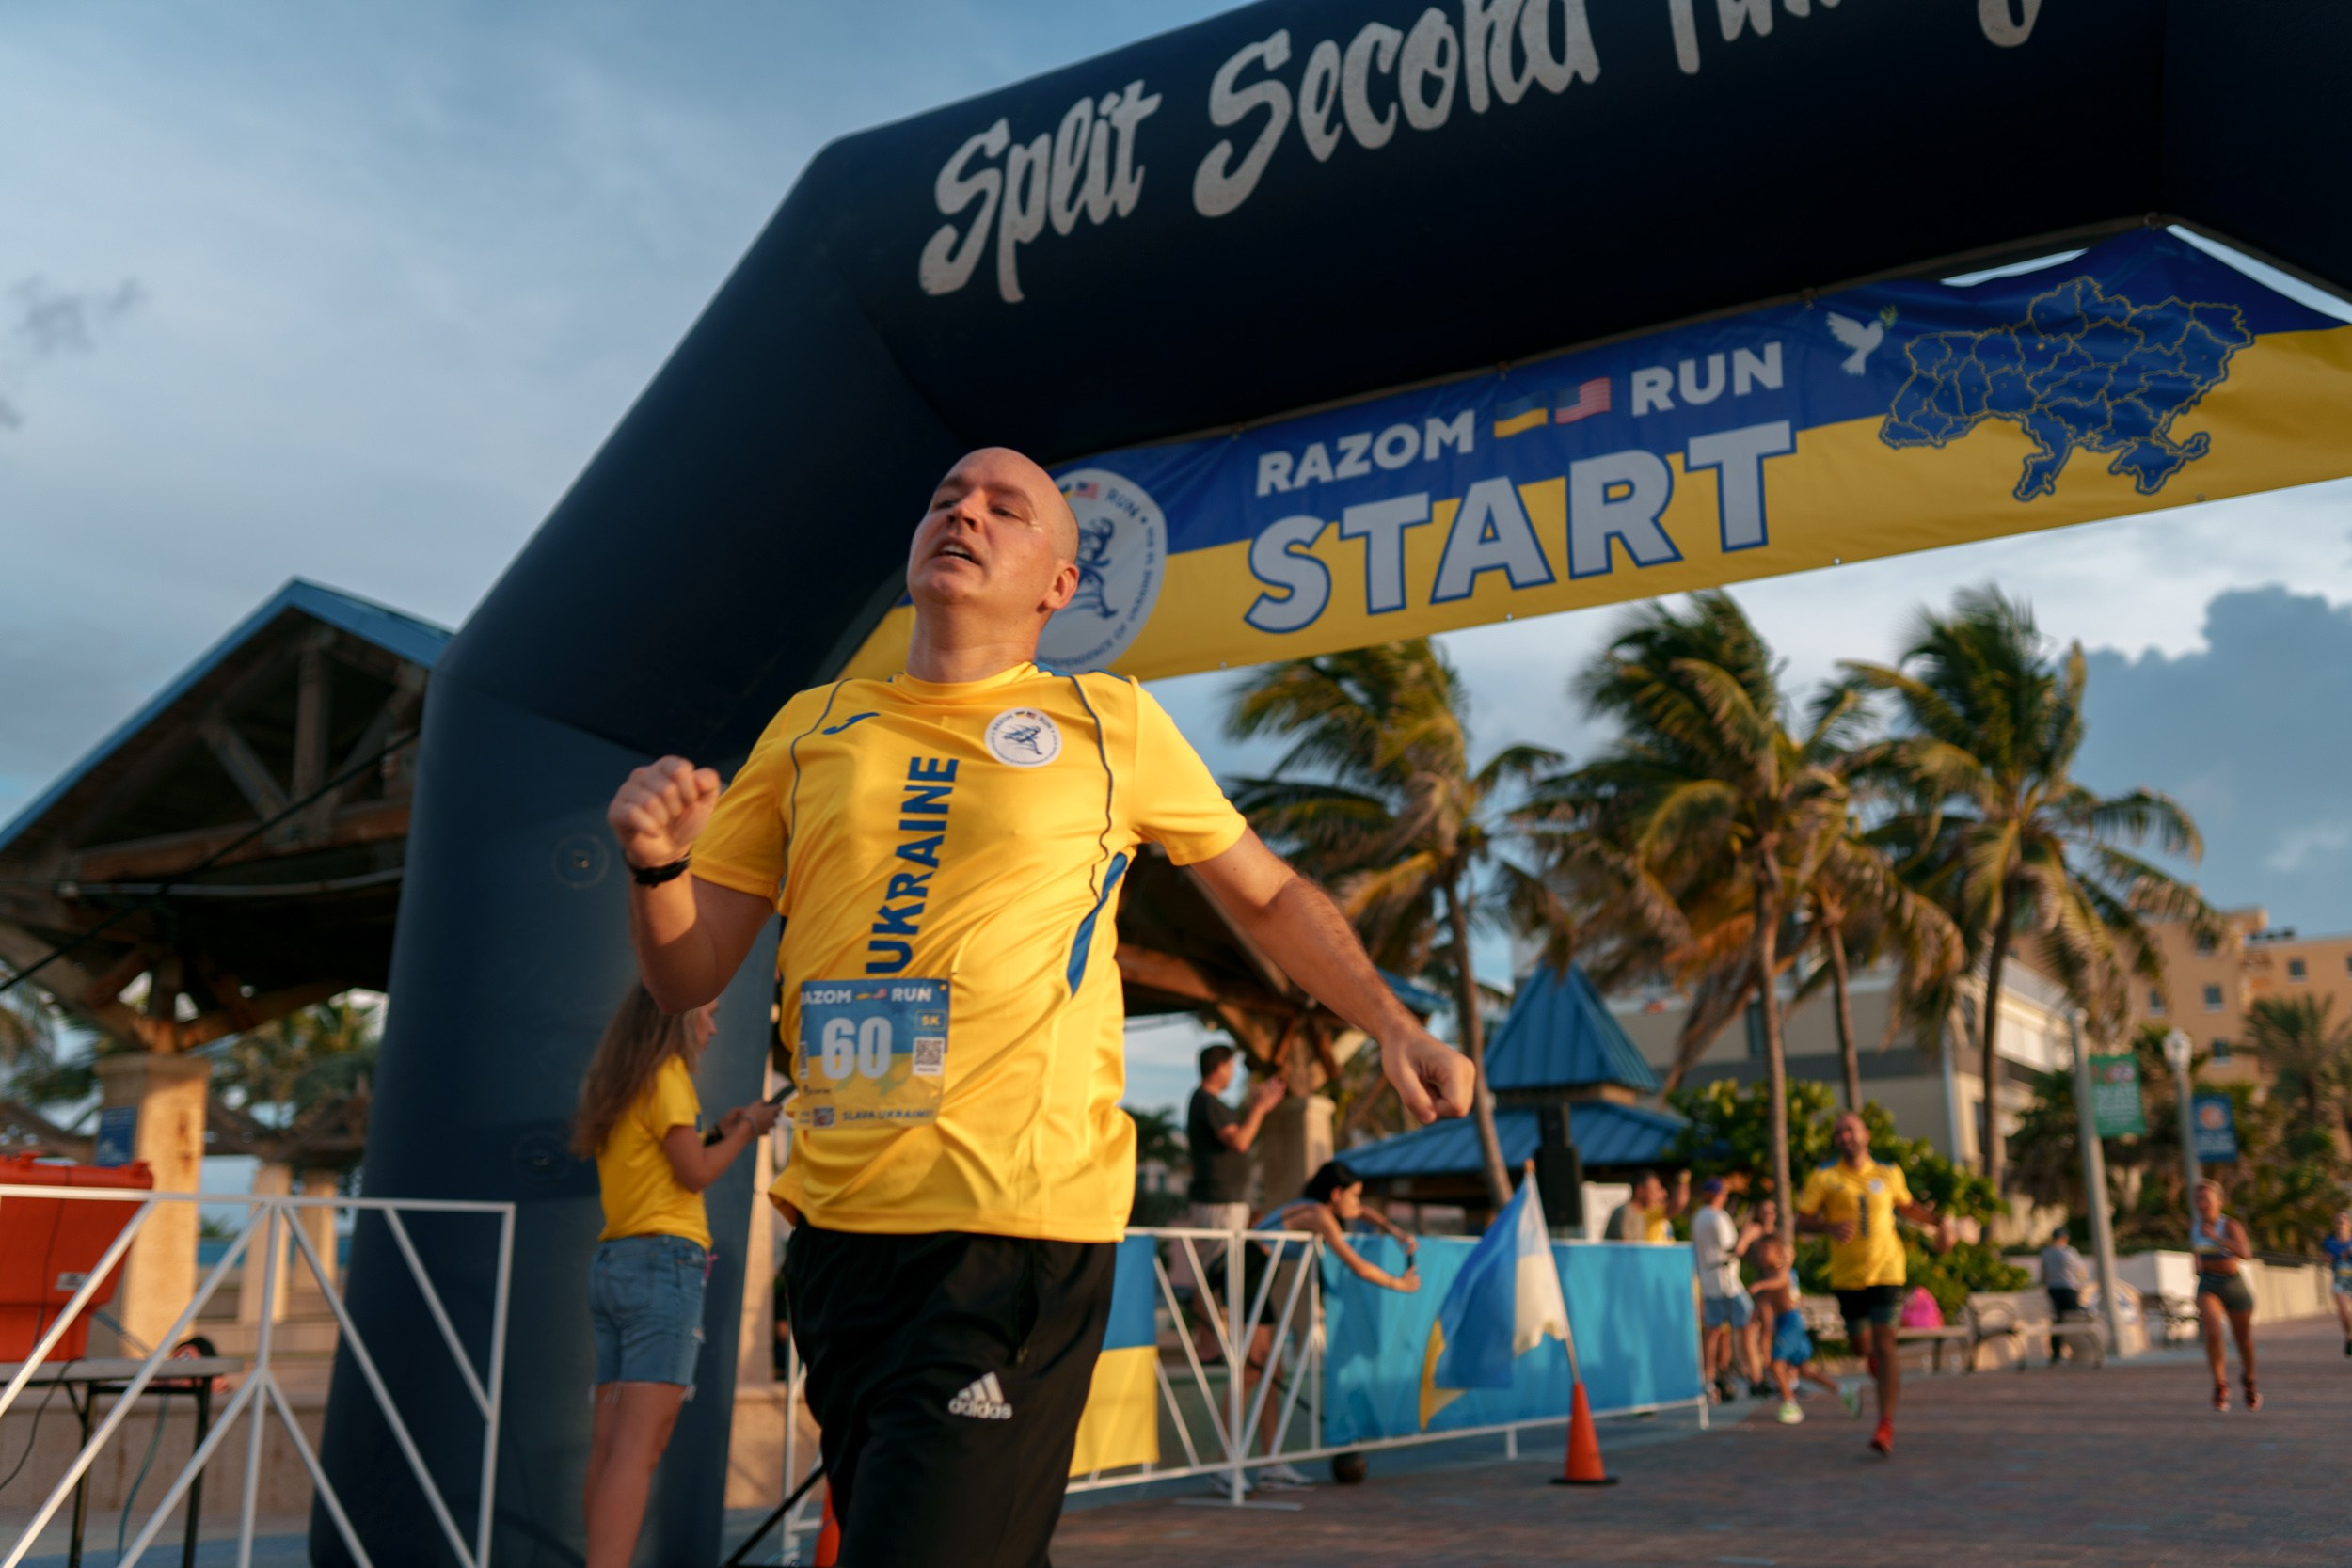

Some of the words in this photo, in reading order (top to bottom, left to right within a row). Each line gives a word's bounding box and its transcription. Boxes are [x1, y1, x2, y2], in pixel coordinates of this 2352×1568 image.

[918, 79, 1163, 304] Split
[1256, 409, 1475, 498] RAZOM
[1630, 341, 1784, 418] RUN
[1243, 420, 1798, 636] START
[865, 756, 960, 974] UKRAINE
[821, 1016, 893, 1080] 60
[891, 987, 931, 1003] RUN
[948, 1397, 1013, 1419] adidas
